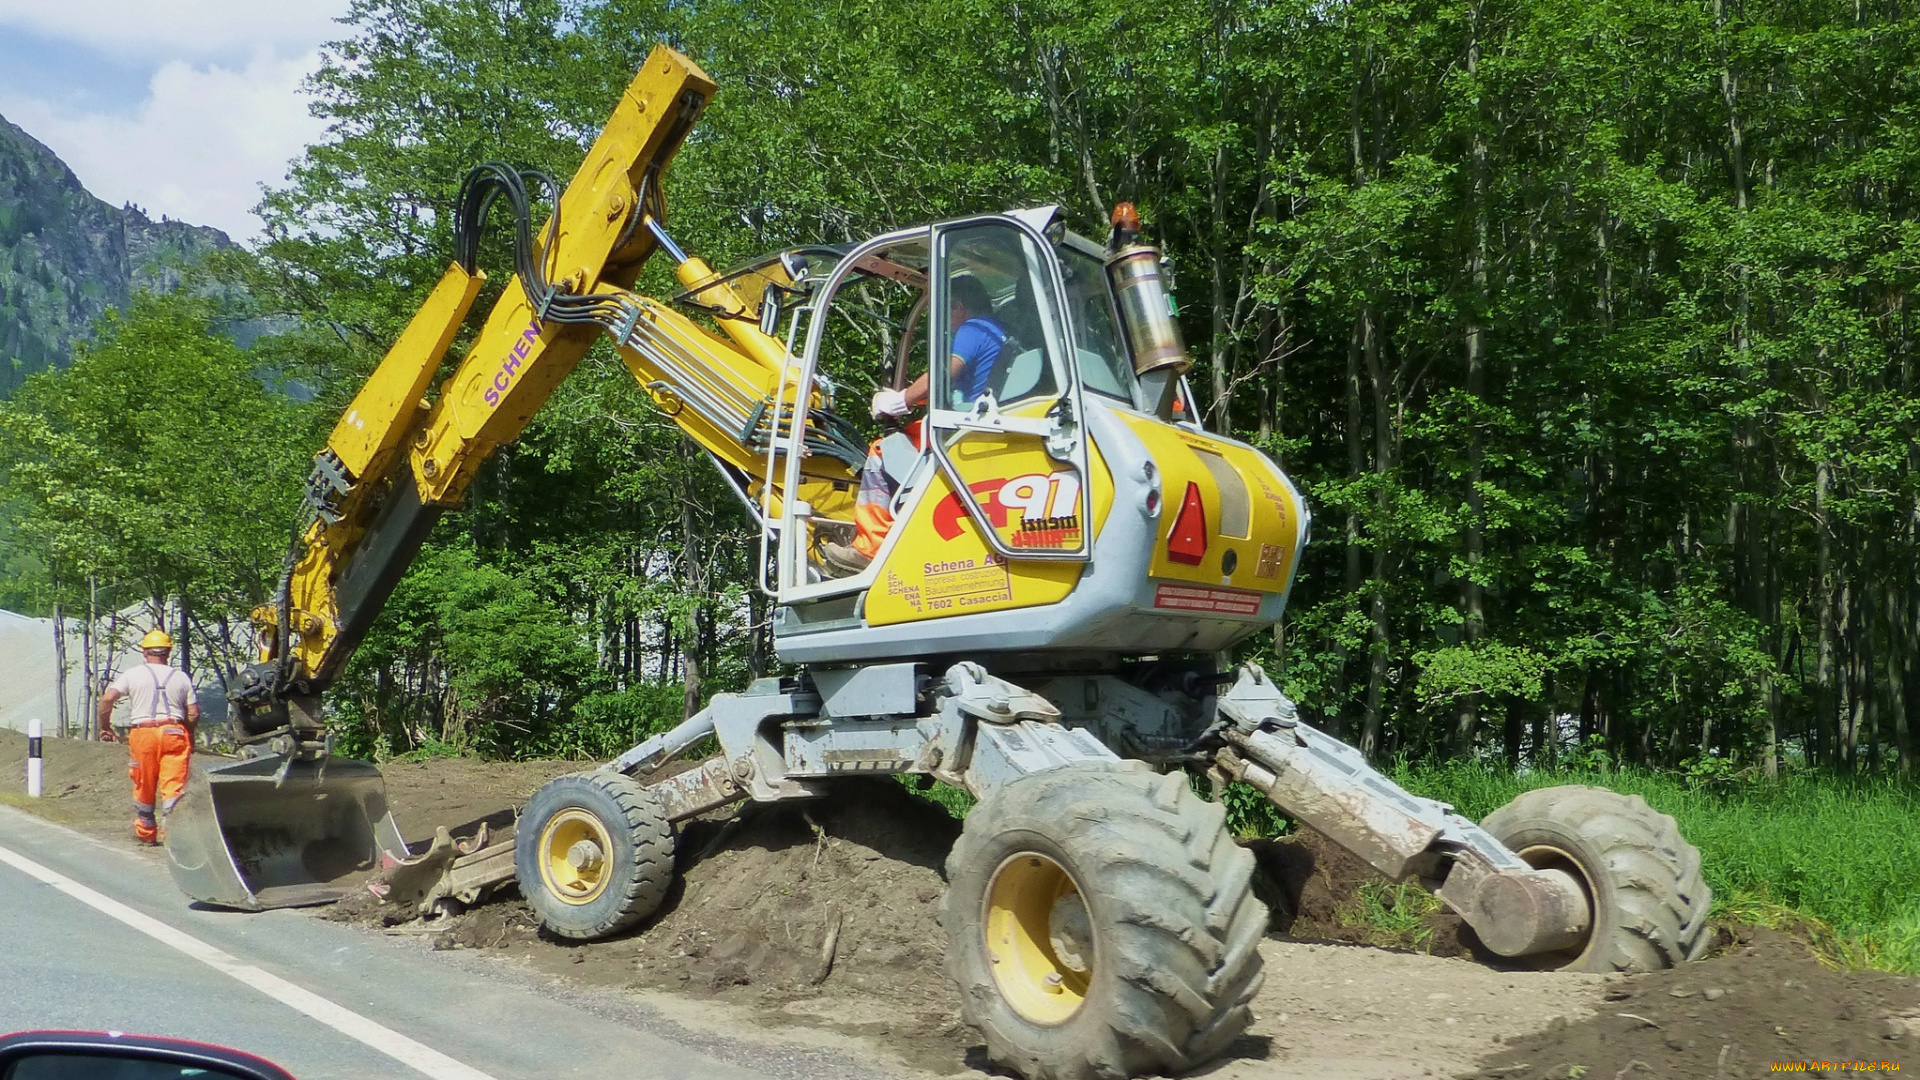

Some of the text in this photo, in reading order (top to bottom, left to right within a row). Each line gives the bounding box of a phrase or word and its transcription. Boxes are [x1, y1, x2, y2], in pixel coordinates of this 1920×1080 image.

[484, 320, 546, 407] SCHEN
[923, 552, 1004, 574] Schena AG
[887, 585, 920, 596] SCHENA
[927, 592, 1009, 611] 7602 Casaccia
